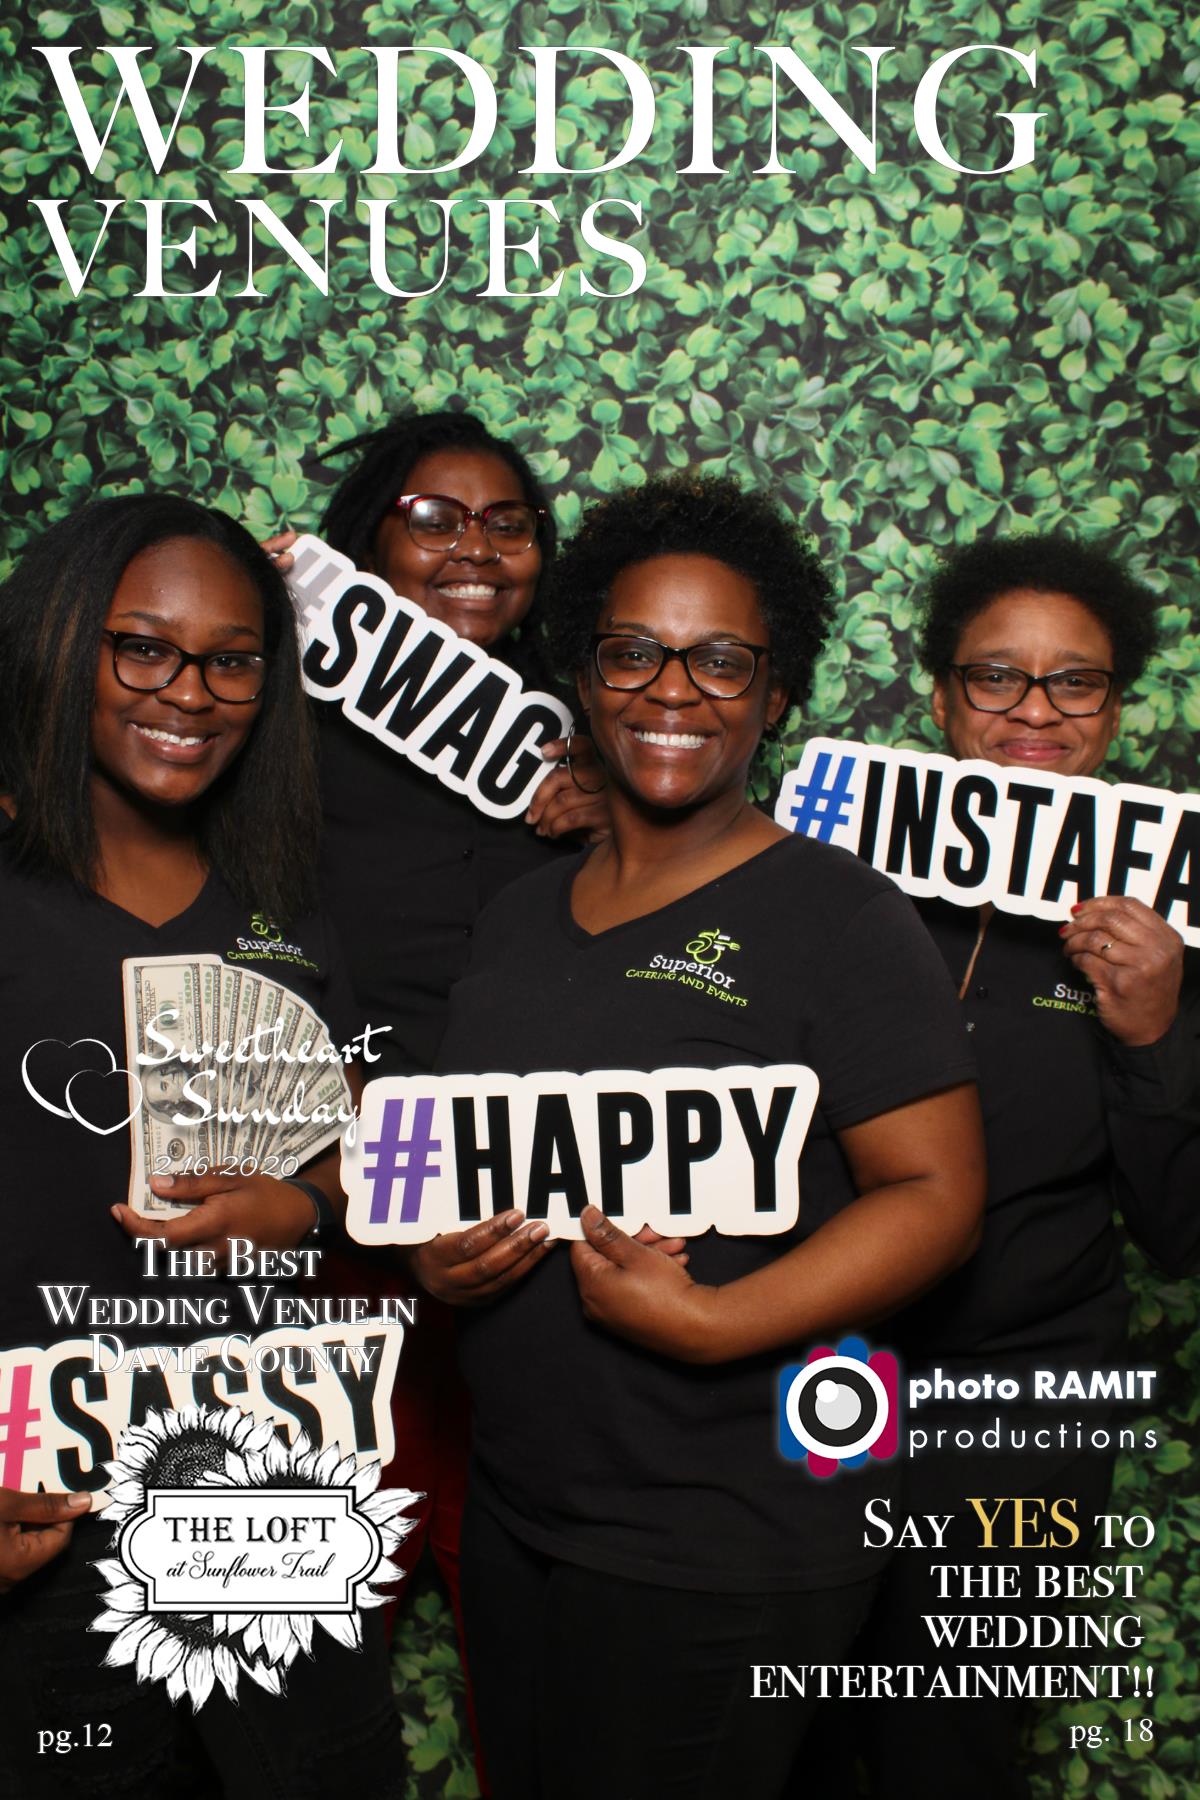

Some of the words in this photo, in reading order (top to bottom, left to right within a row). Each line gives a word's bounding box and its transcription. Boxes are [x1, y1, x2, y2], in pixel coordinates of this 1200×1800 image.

[625, 968, 677, 981] CATERING
[678, 974, 705, 990] AND
[706, 985, 749, 1007] EVENTS
[649, 954, 736, 989] Superior
[1032, 996, 1087, 1014] CATERING
[363, 1086, 797, 1224] #HAPPY
